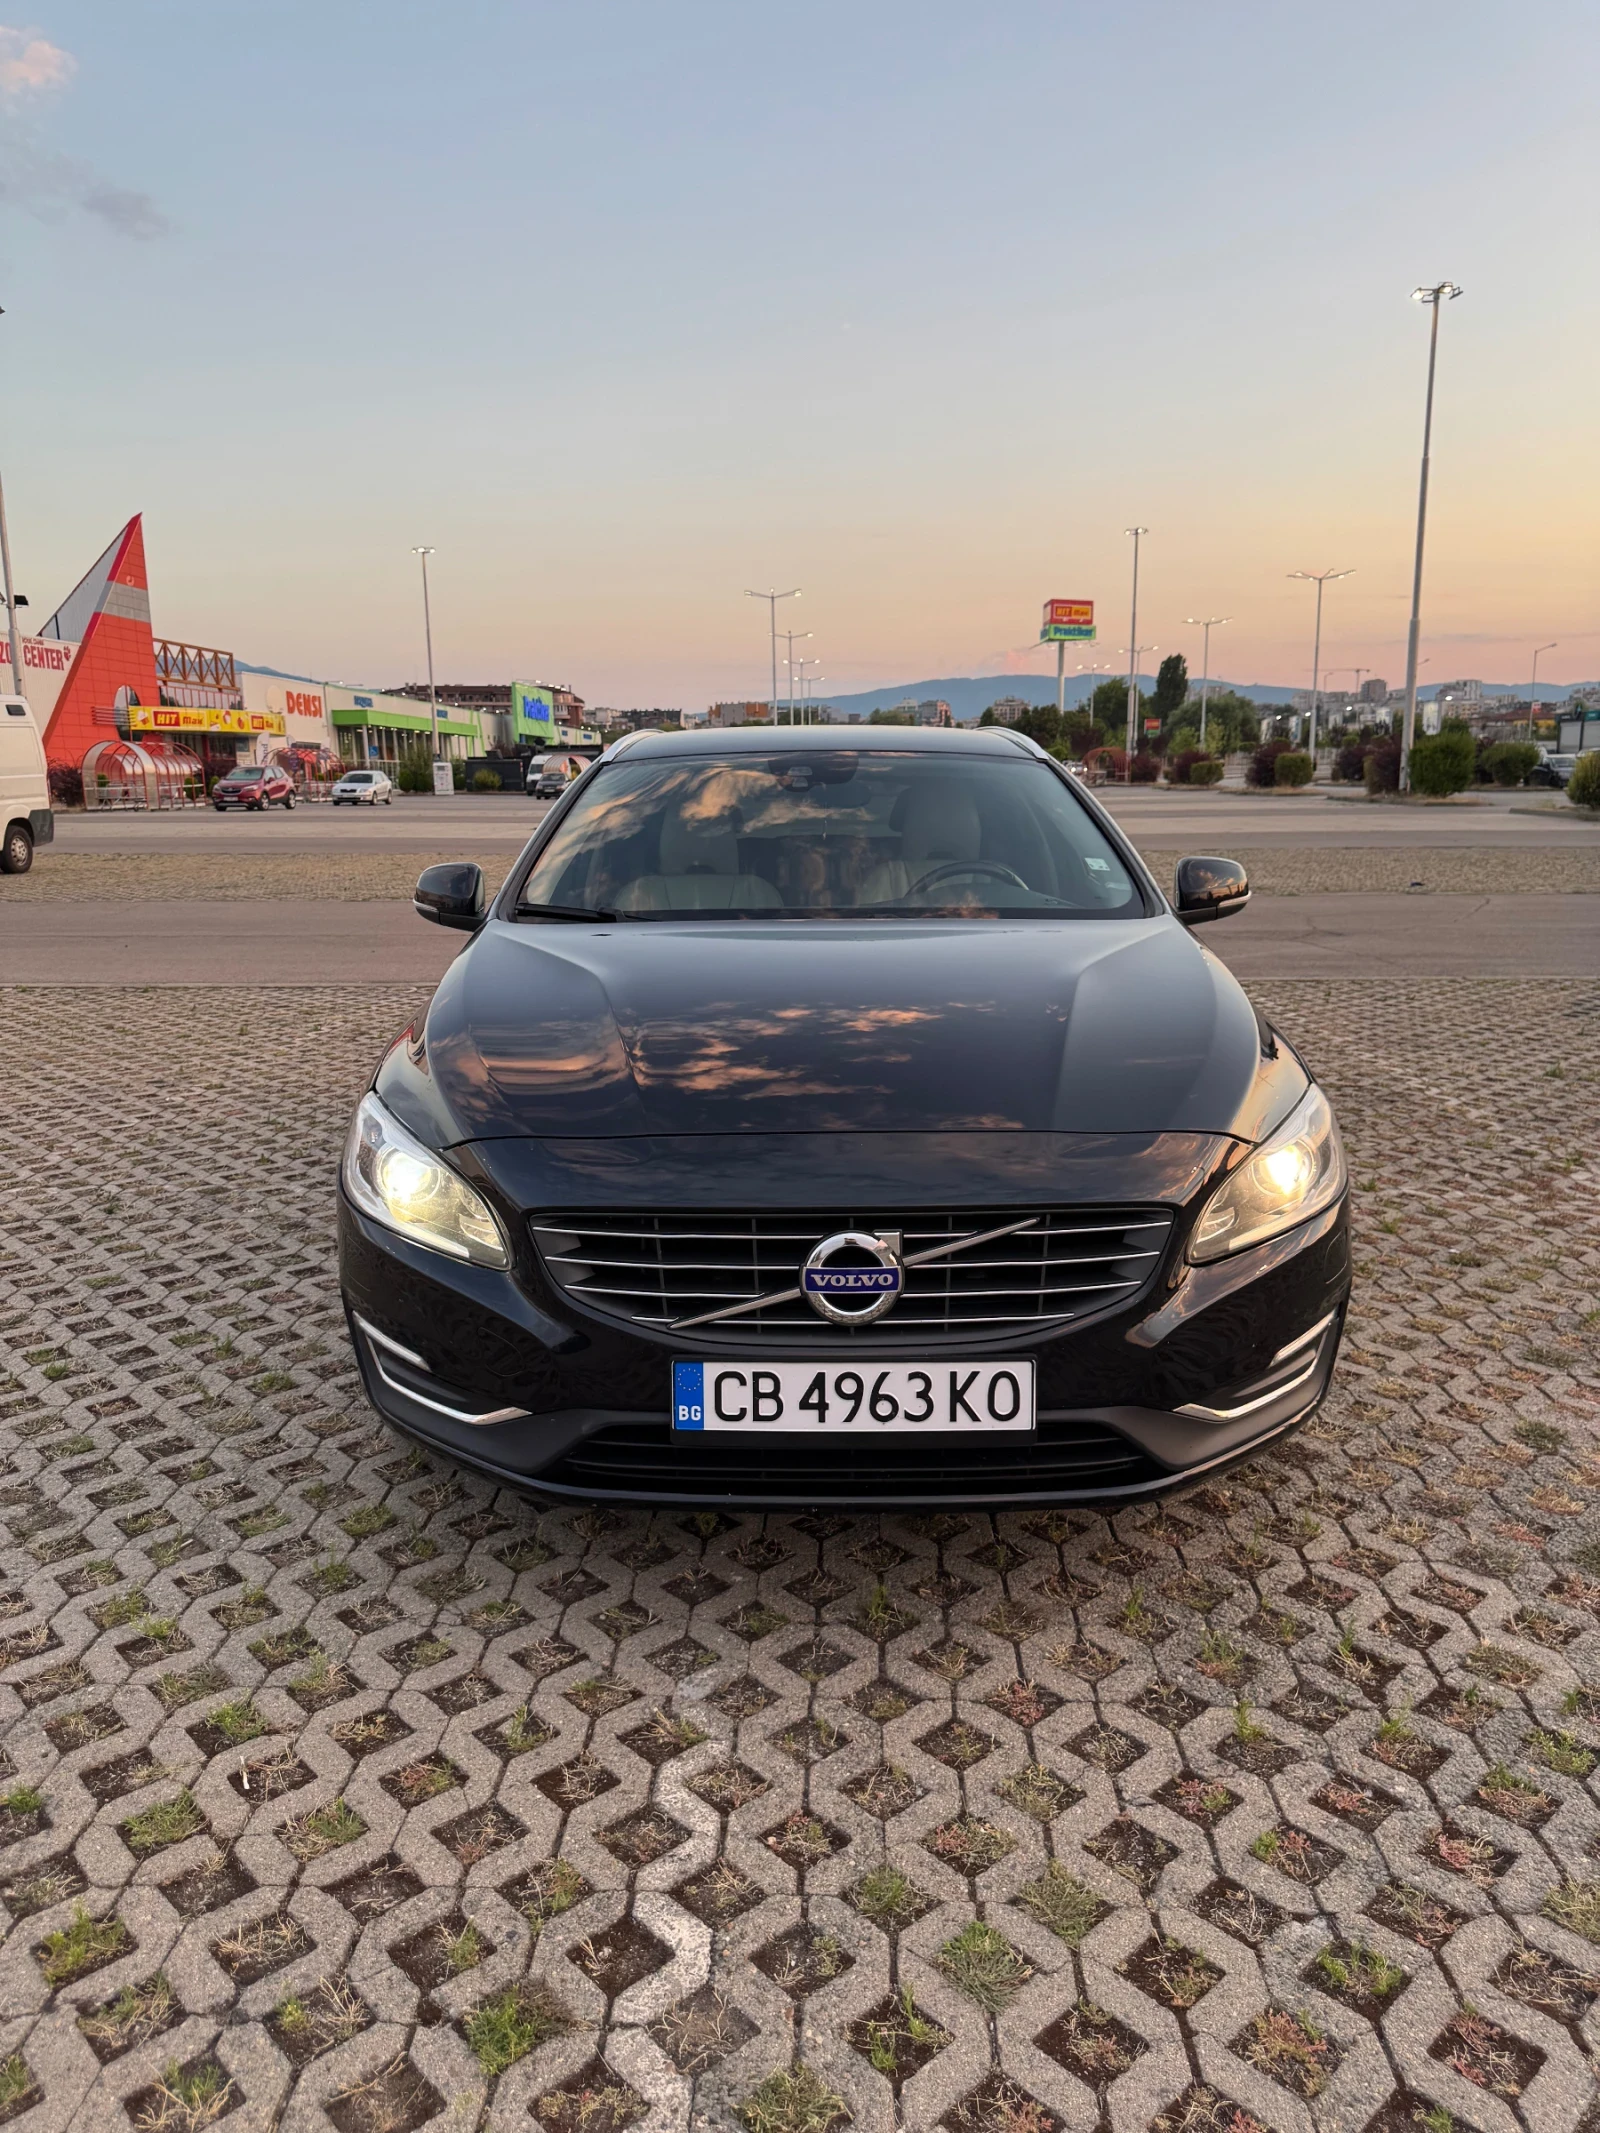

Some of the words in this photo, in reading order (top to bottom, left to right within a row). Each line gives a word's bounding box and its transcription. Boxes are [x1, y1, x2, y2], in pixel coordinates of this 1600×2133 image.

[23, 645, 64, 670] CENTER
[286, 691, 322, 718] DENSI
[157, 713, 177, 724] HIT
[810, 1274, 894, 1287] VOLVO
[678, 1405, 701, 1421] BG
[714, 1370, 784, 1421] CB
[798, 1371, 935, 1422] 4963
[949, 1370, 1021, 1422] KO
